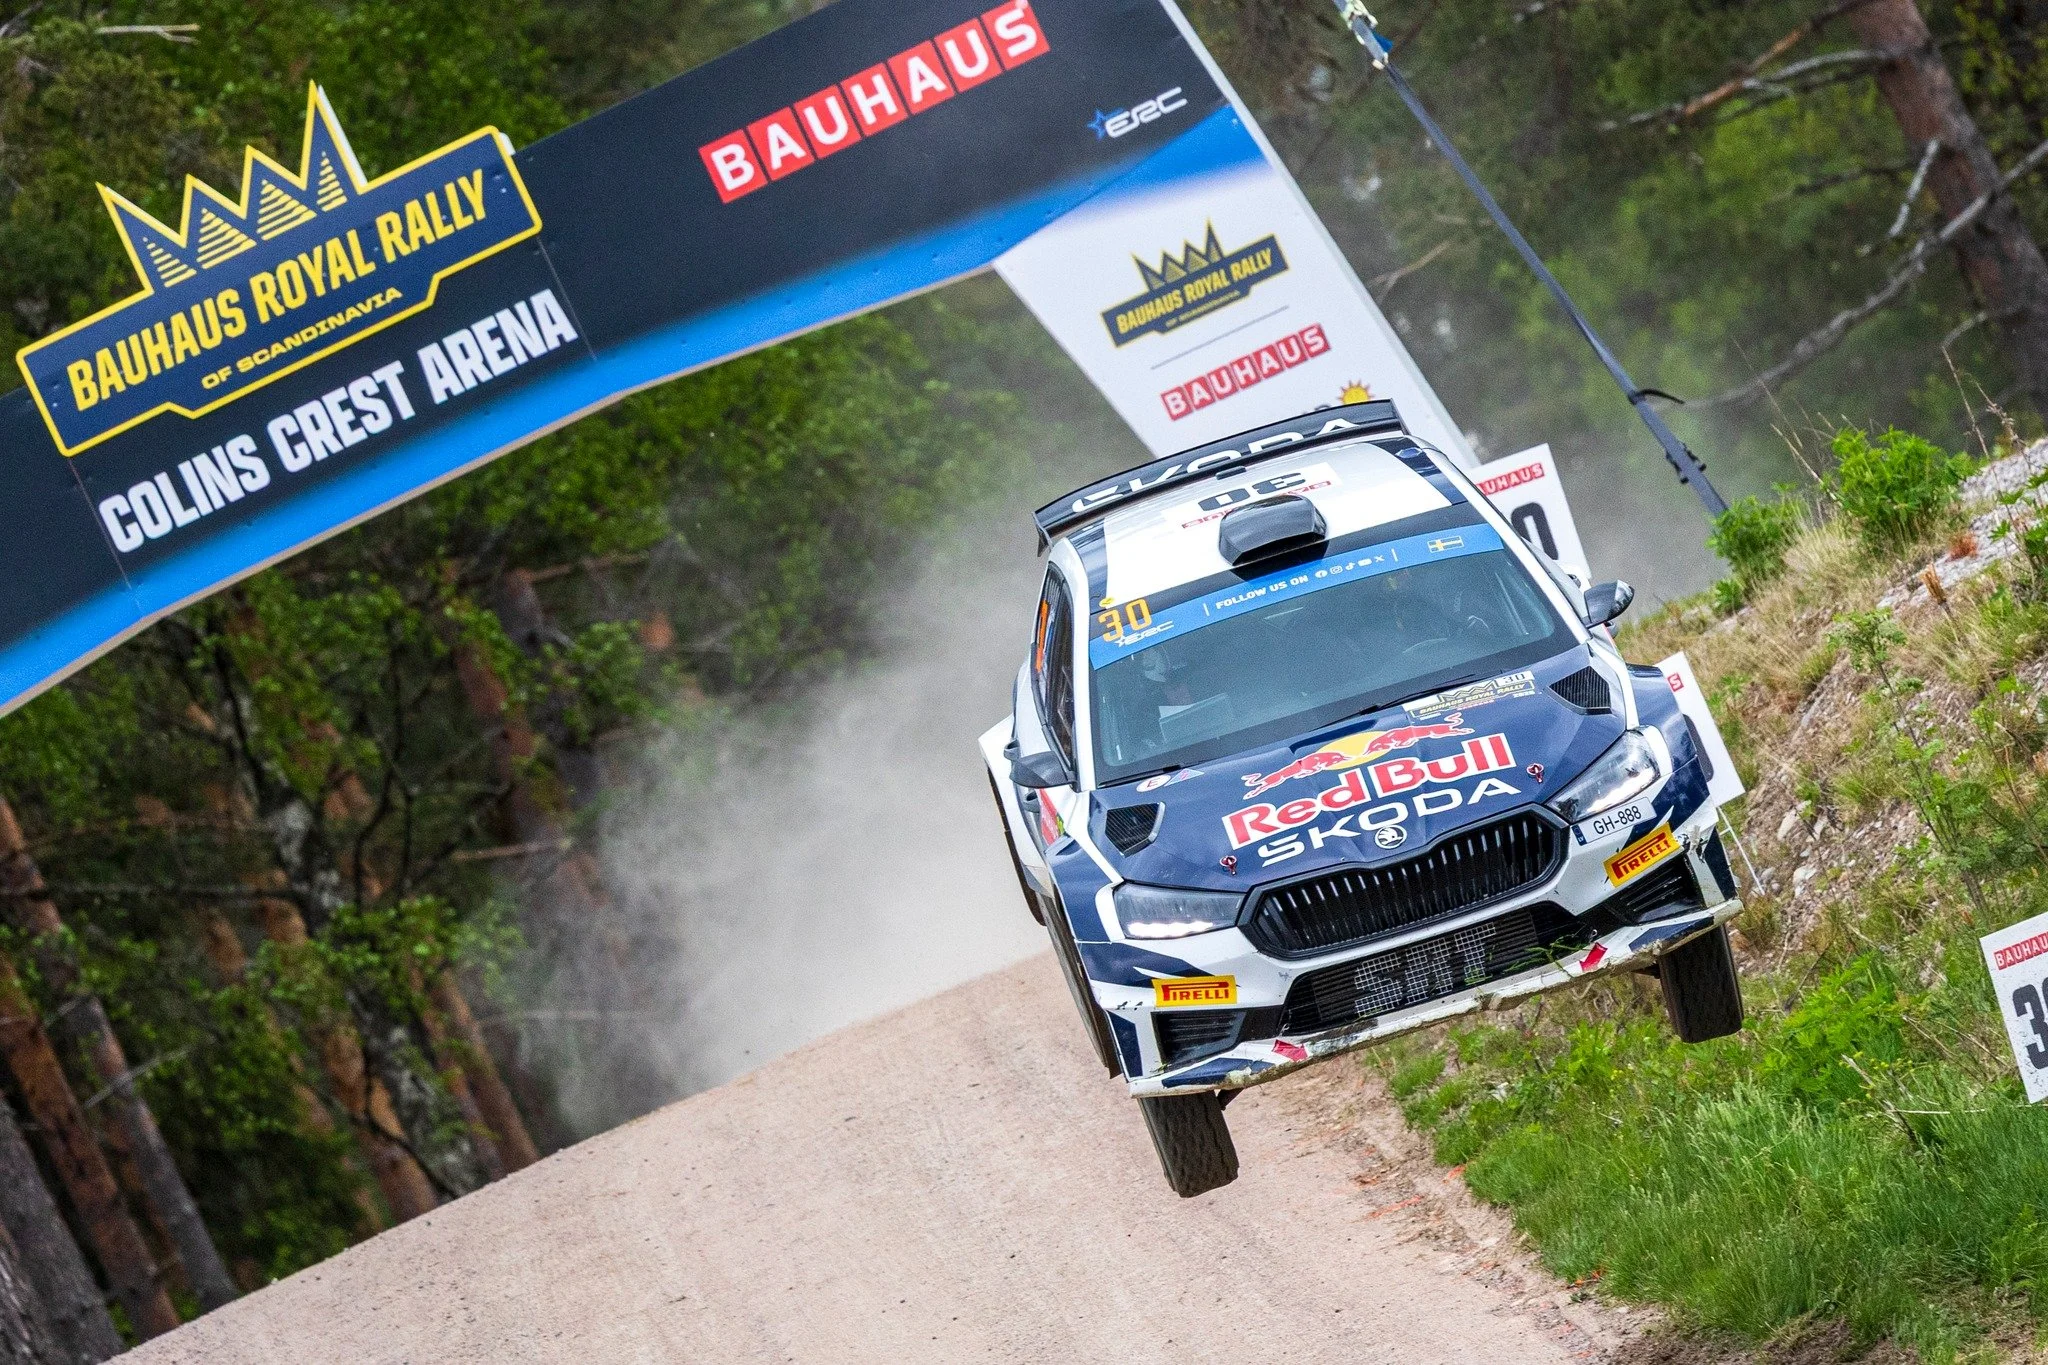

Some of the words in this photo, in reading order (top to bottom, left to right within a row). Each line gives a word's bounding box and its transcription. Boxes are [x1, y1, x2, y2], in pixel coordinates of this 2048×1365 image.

[708, 6, 1038, 192] BAUHAUS
[1105, 86, 1188, 138] ERC
[66, 288, 249, 412] BAUHAUS
[249, 229, 376, 324] ROYAL
[376, 168, 486, 264] RALLY
[1116, 288, 1184, 334] BAUHAUS
[1184, 271, 1231, 302] ROYAL
[1230, 247, 1272, 282] RALLY
[201, 364, 234, 390] OF
[239, 286, 403, 373] SCANDINAVIA
[1163, 326, 1327, 419] BAUHAUS
[98, 433, 271, 553] COLINS
[266, 360, 417, 473] CREST
[416, 288, 579, 405] ARENA
[1477, 463, 1544, 495] UHAUS
[1215, 587, 1267, 610] FOLLOW
[1269, 581, 1288, 592] US
[1289, 575, 1309, 586] ON
[1098, 598, 1152, 643] 30
[1419, 697, 1465, 714] BAUHAUS
[1465, 690, 1496, 702] ROYAL
[1496, 683, 1526, 694] RALLY
[1227, 769, 1368, 847] Red
[1372, 735, 1513, 795] Bull
[1593, 805, 1642, 835] GH-888
[1611, 831, 1672, 879] PIRELLI
[1995, 934, 2048, 968] BAUHAU
[1162, 980, 1230, 1001] PIRELLI
[2012, 978, 2048, 1069] 3
